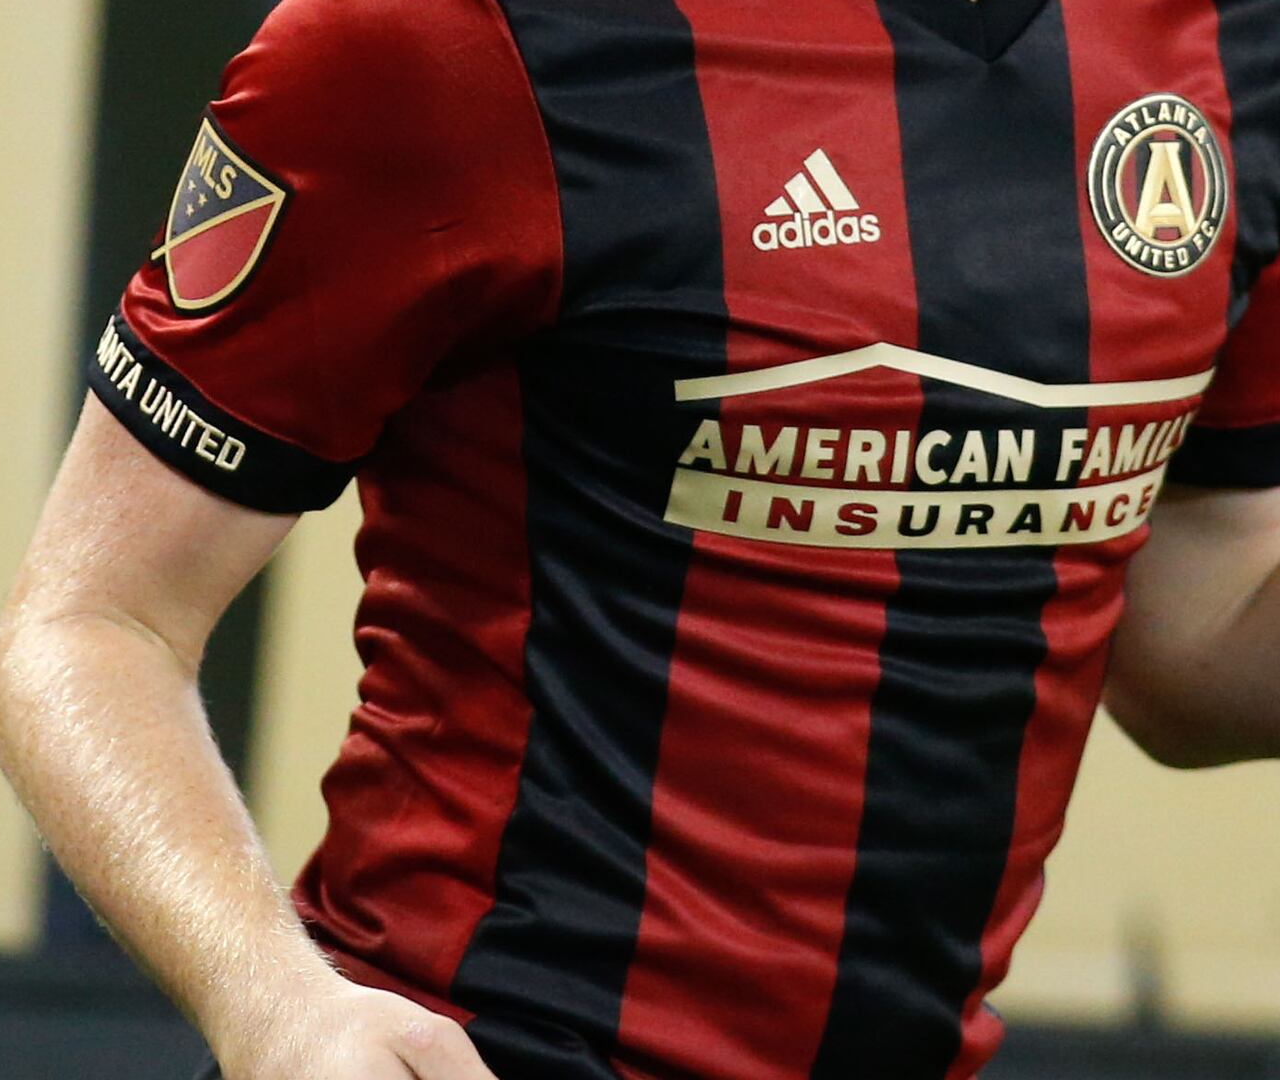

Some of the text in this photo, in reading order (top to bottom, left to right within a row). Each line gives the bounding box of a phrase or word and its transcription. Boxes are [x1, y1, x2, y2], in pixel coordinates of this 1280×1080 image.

[1112, 102, 1208, 146] ATLANTA
[193, 135, 239, 200] MLS
[1135, 141, 1197, 239] A
[752, 212, 881, 251] adidas
[1111, 220, 1215, 268] UNITED FC
[139, 378, 247, 470] UNITED
[677, 419, 1035, 486] AMERICAN
[722, 483, 1154, 537] INSURANCE
